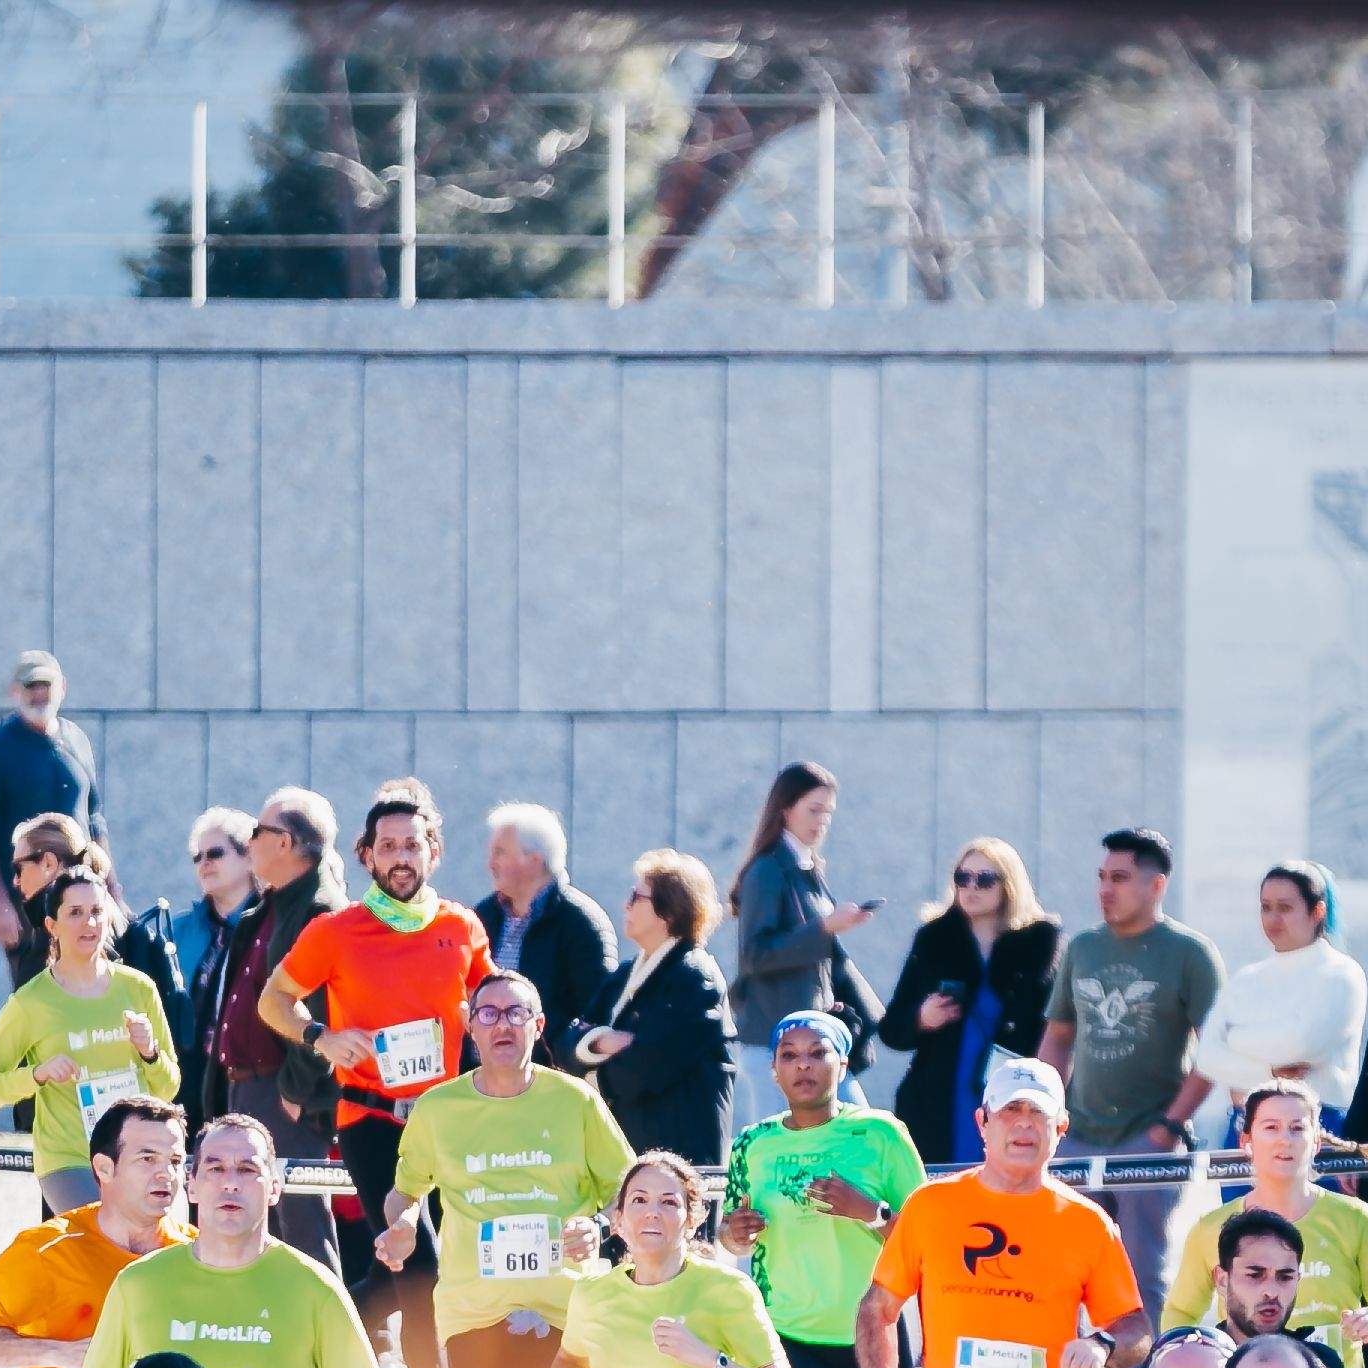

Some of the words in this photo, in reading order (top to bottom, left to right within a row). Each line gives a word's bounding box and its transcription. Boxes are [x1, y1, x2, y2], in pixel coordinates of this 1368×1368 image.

[491, 1151, 552, 1168] MetLife
[512, 1222, 544, 1231] MetLife
[506, 1253, 538, 1271] 616
[1299, 1261, 1331, 1277] Life
[199, 1323, 272, 1343] MetLife
[992, 1349, 1028, 1360] MetLife
